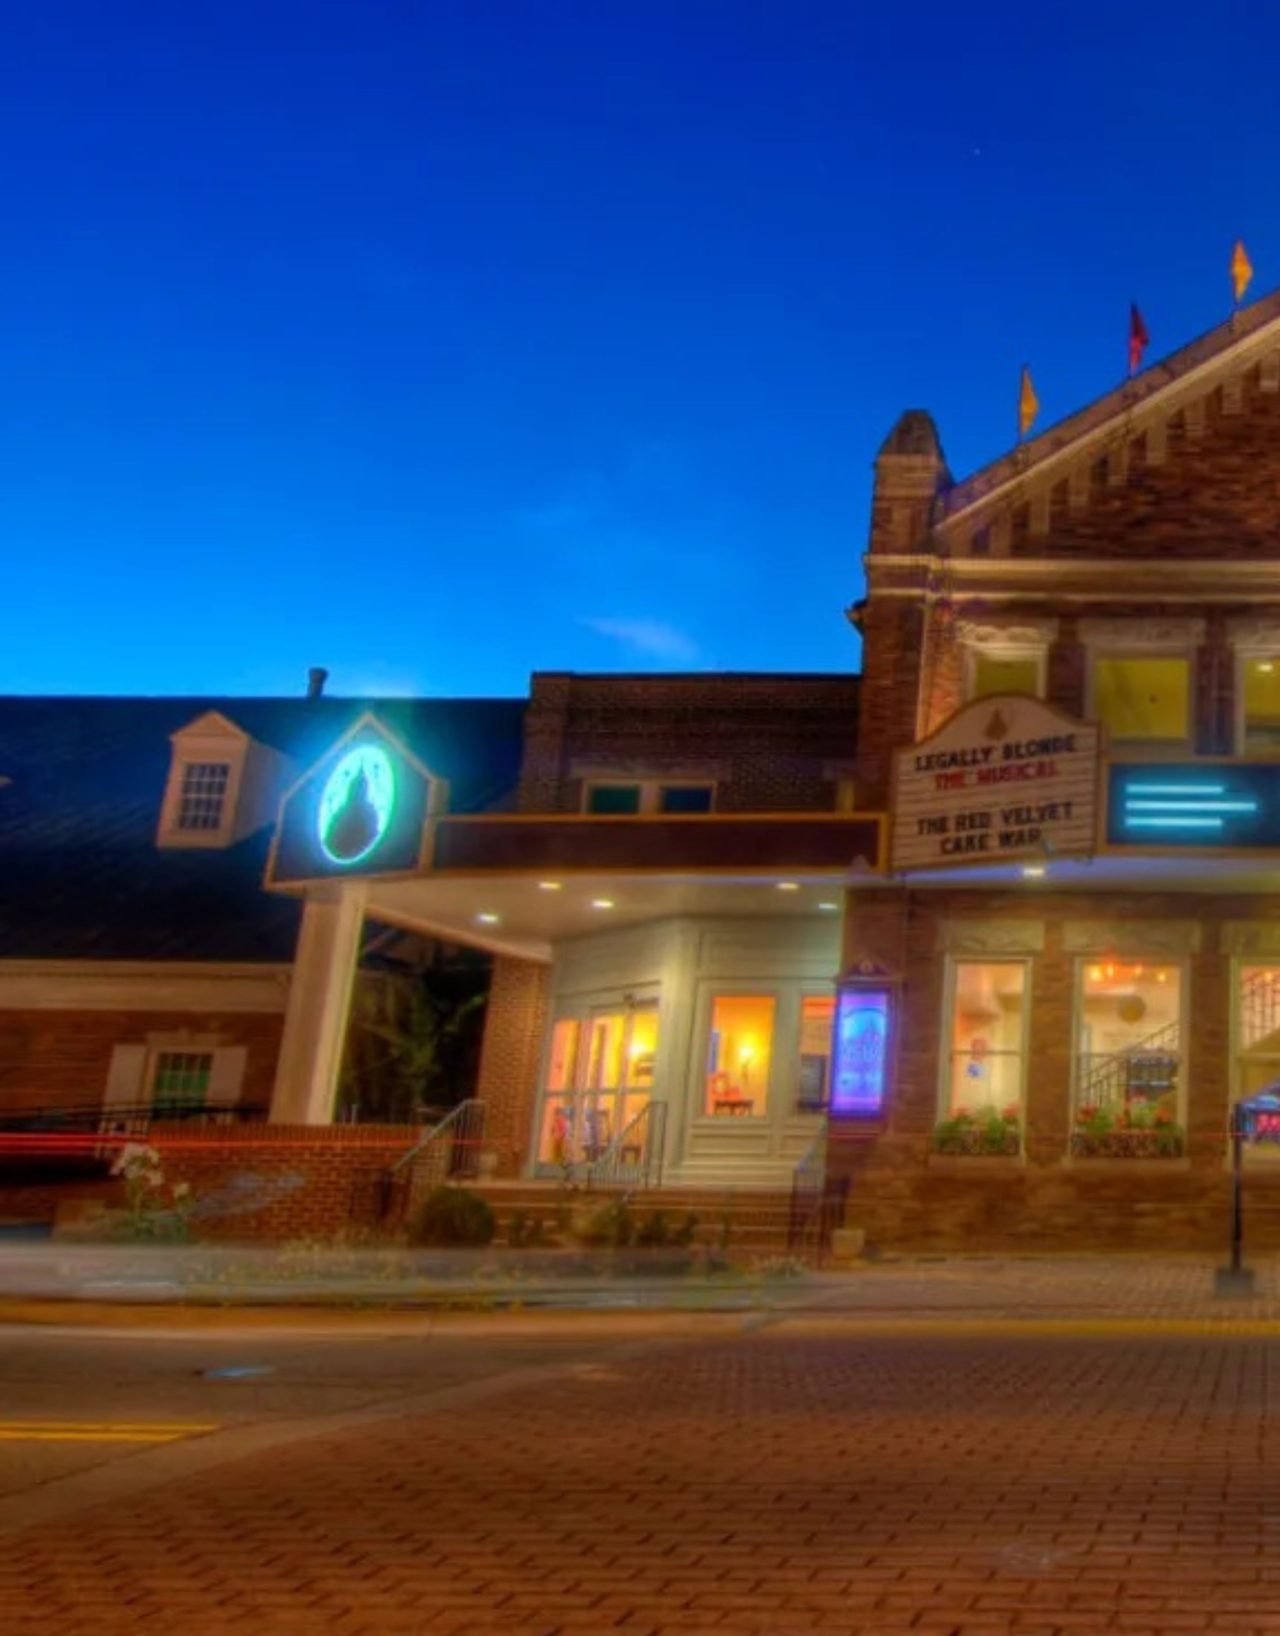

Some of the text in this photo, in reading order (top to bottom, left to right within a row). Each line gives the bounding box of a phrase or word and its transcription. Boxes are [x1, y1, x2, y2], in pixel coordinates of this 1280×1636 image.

[915, 734, 1077, 772] LEGALLY BLONDE
[935, 760, 1057, 791] THE MUSICAL
[917, 801, 1073, 836] THE RED VELVET
[940, 827, 1042, 855] CAKE WAR
